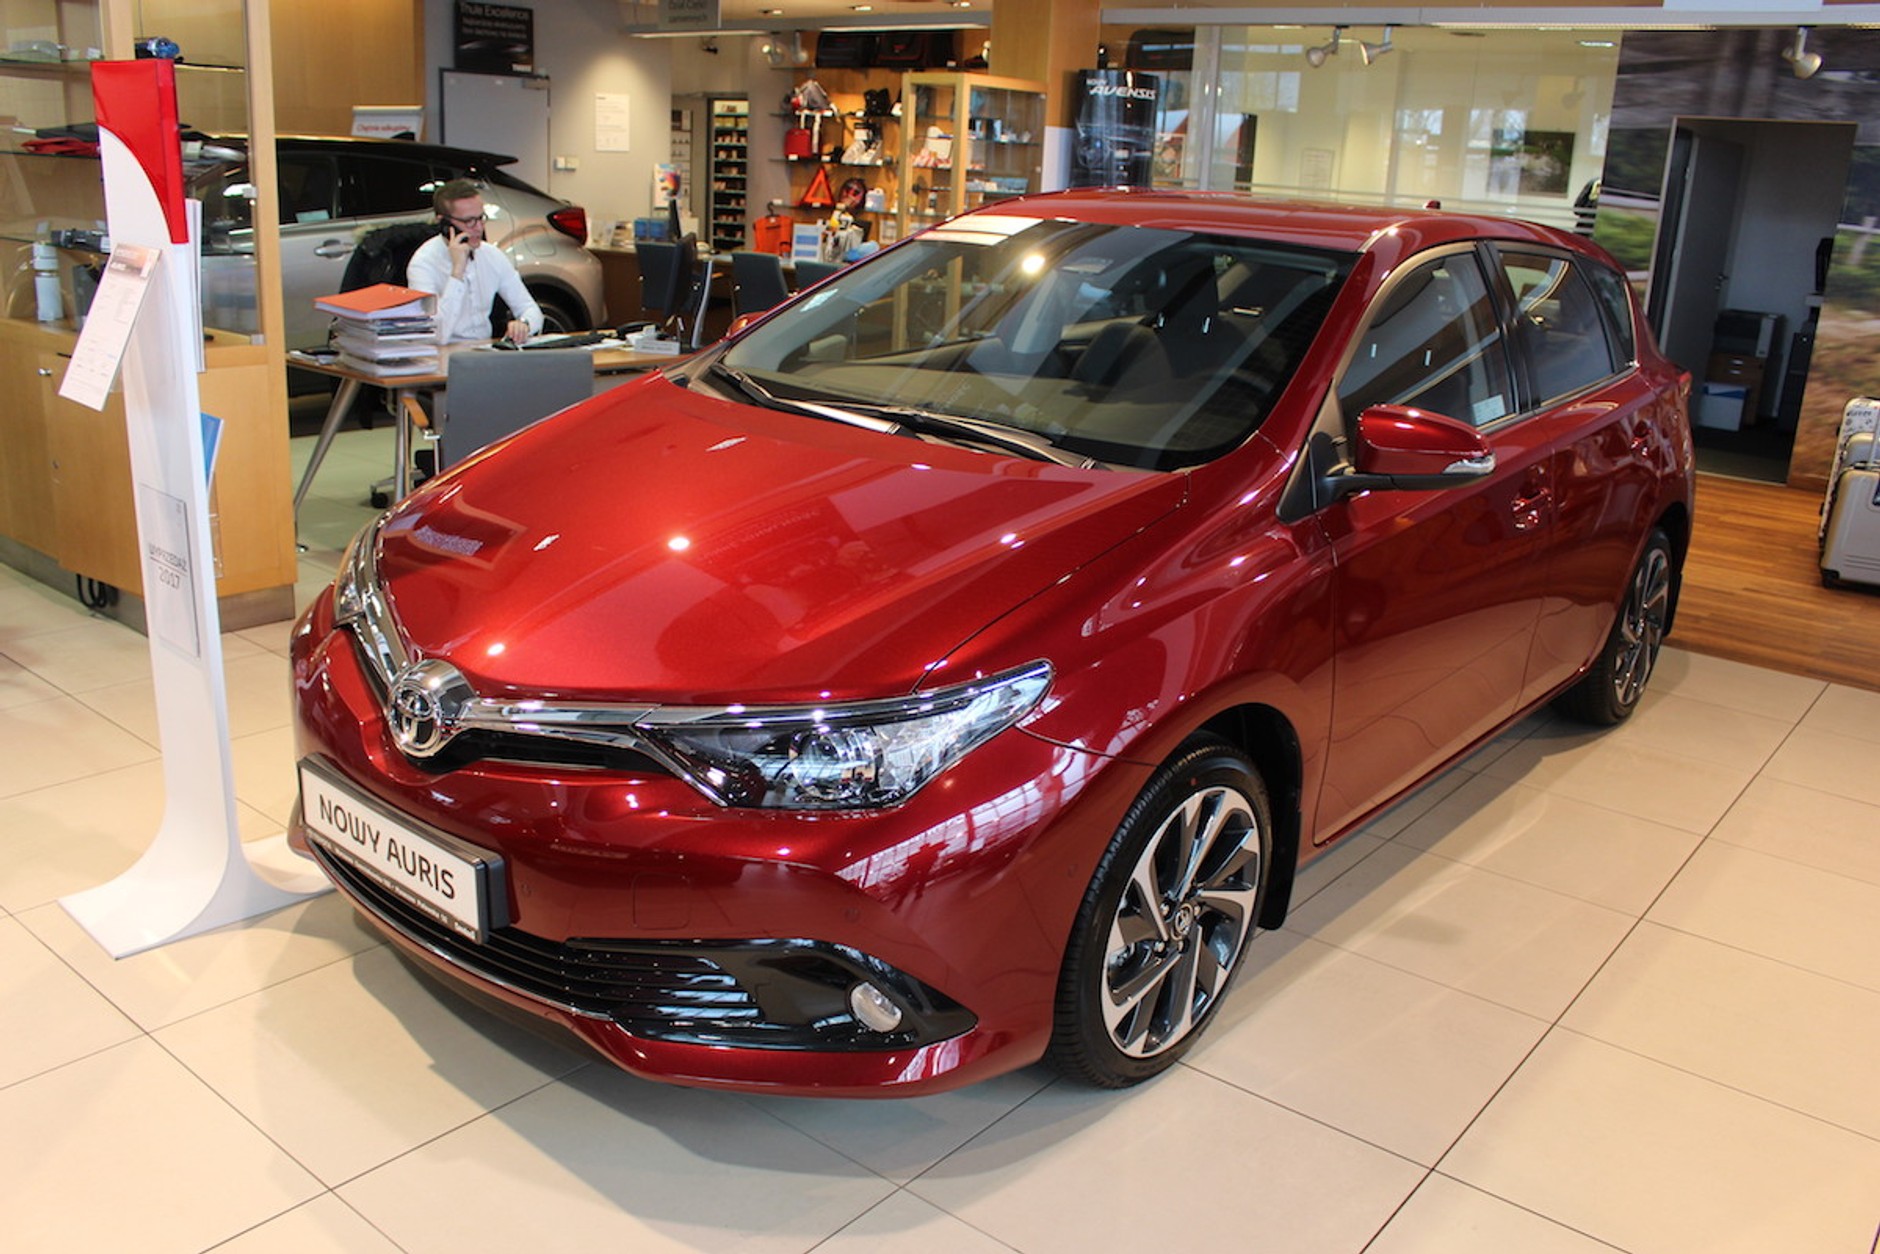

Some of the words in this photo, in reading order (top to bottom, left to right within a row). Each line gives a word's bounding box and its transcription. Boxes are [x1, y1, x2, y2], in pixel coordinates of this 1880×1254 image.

[1089, 86, 1156, 100] AVENSIS
[158, 566, 180, 589] 2017
[319, 794, 381, 853] NOWY
[387, 838, 456, 900] AURIS
